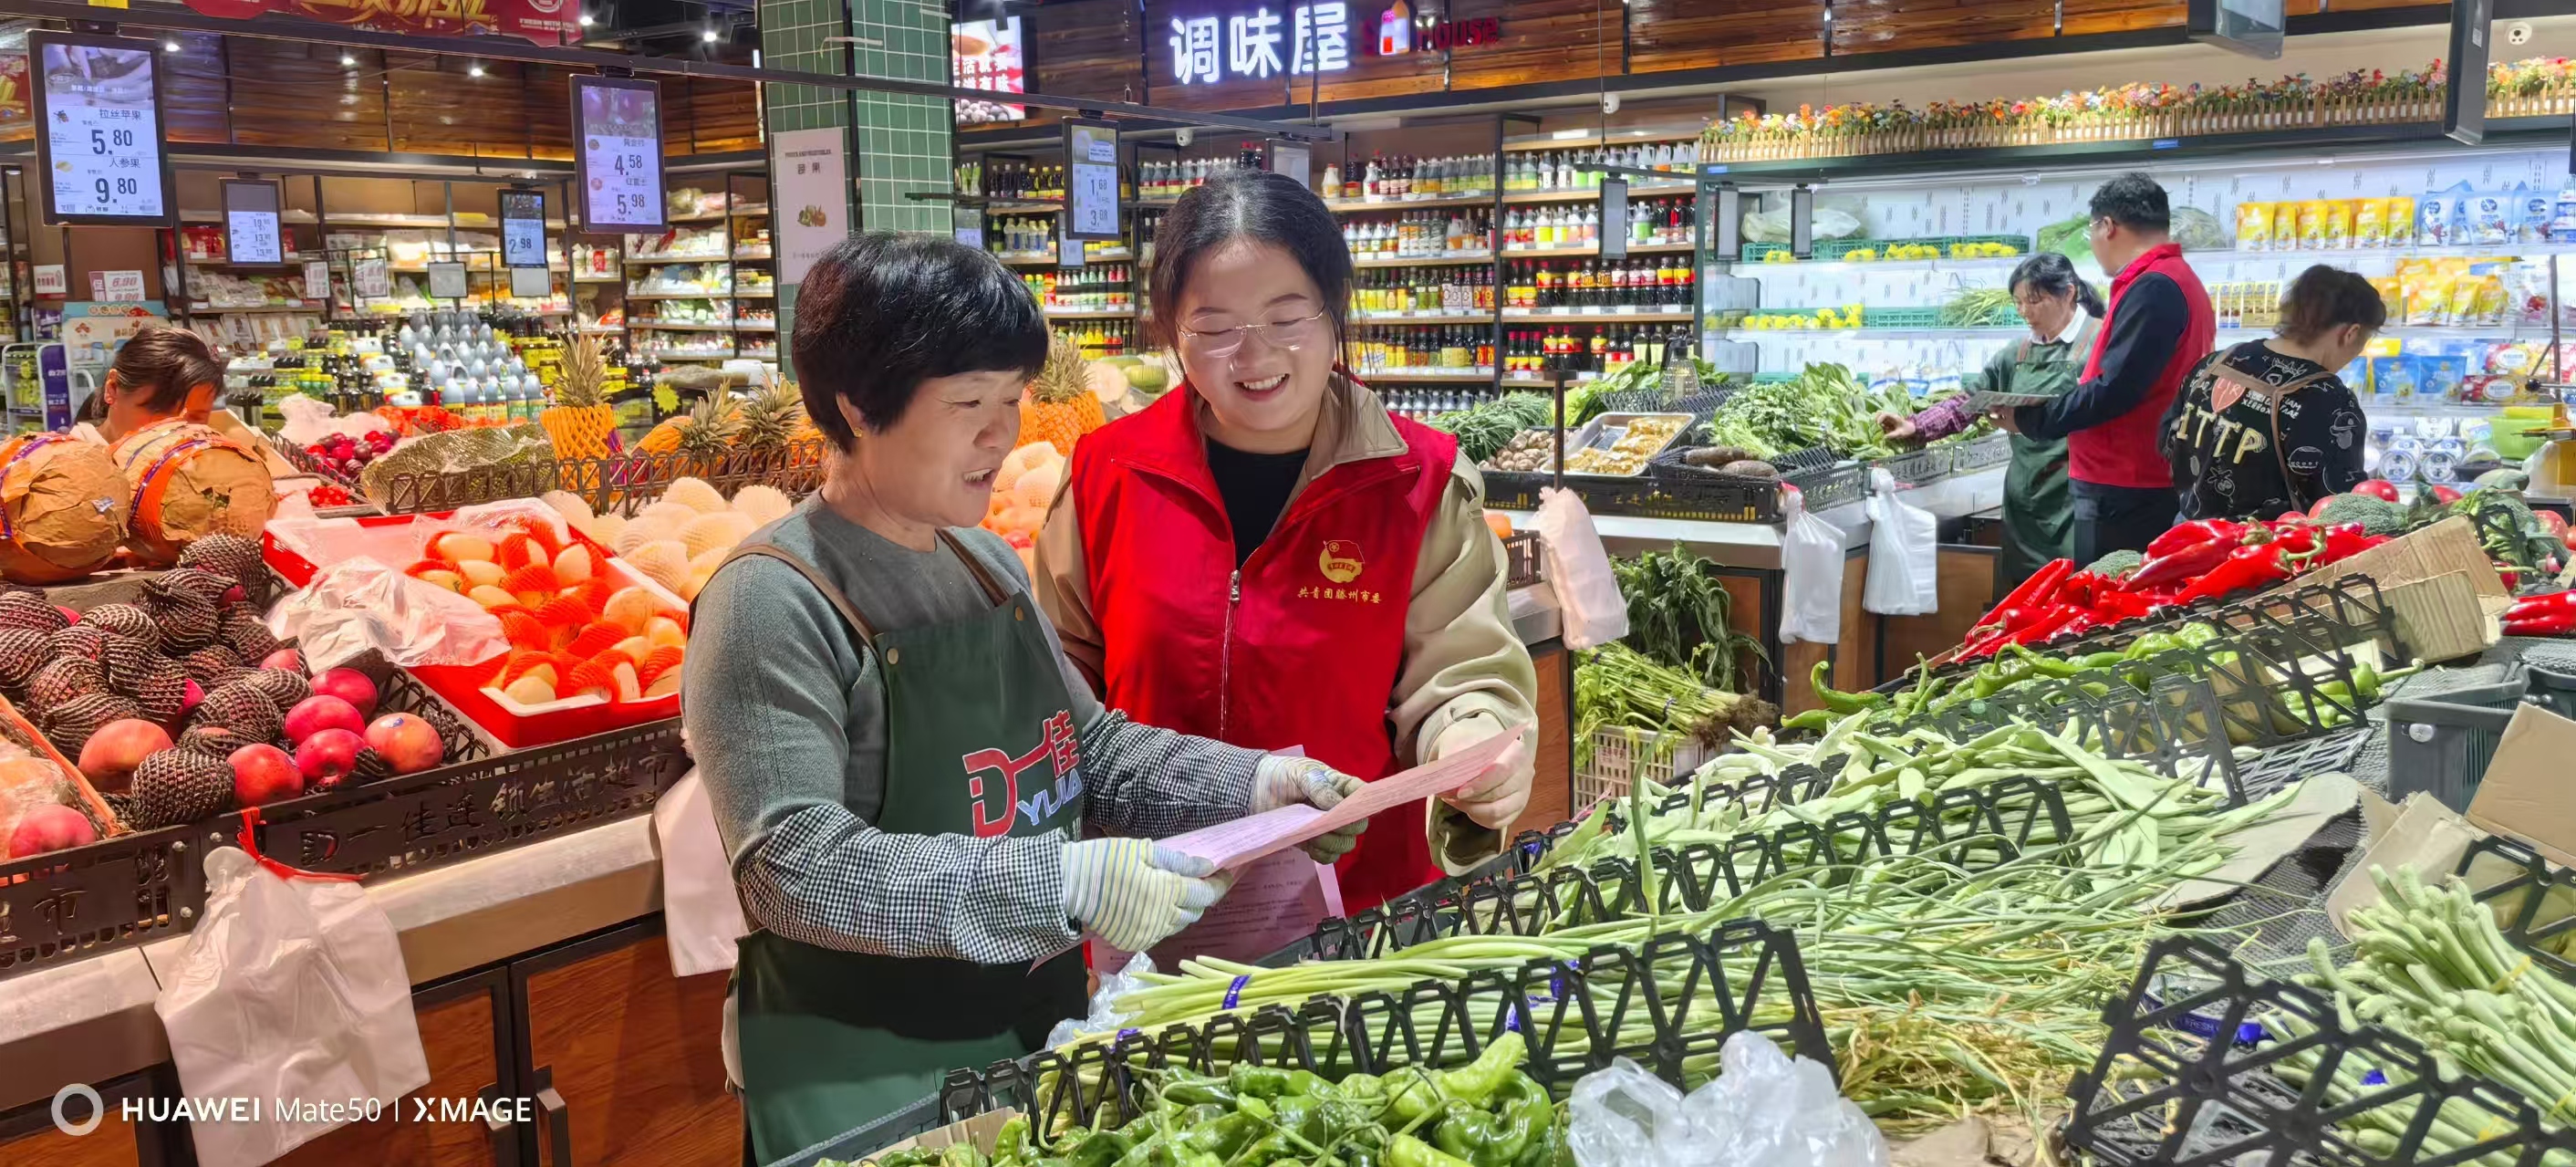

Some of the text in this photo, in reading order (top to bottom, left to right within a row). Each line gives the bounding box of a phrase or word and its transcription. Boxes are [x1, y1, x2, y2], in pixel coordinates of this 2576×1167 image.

[1169, 3, 1349, 84] 调味屋
[91, 129, 133, 155] 5.80
[614, 154, 643, 176] 4.58
[95, 178, 137, 204] 9.80
[617, 193, 645, 215] 5.98
